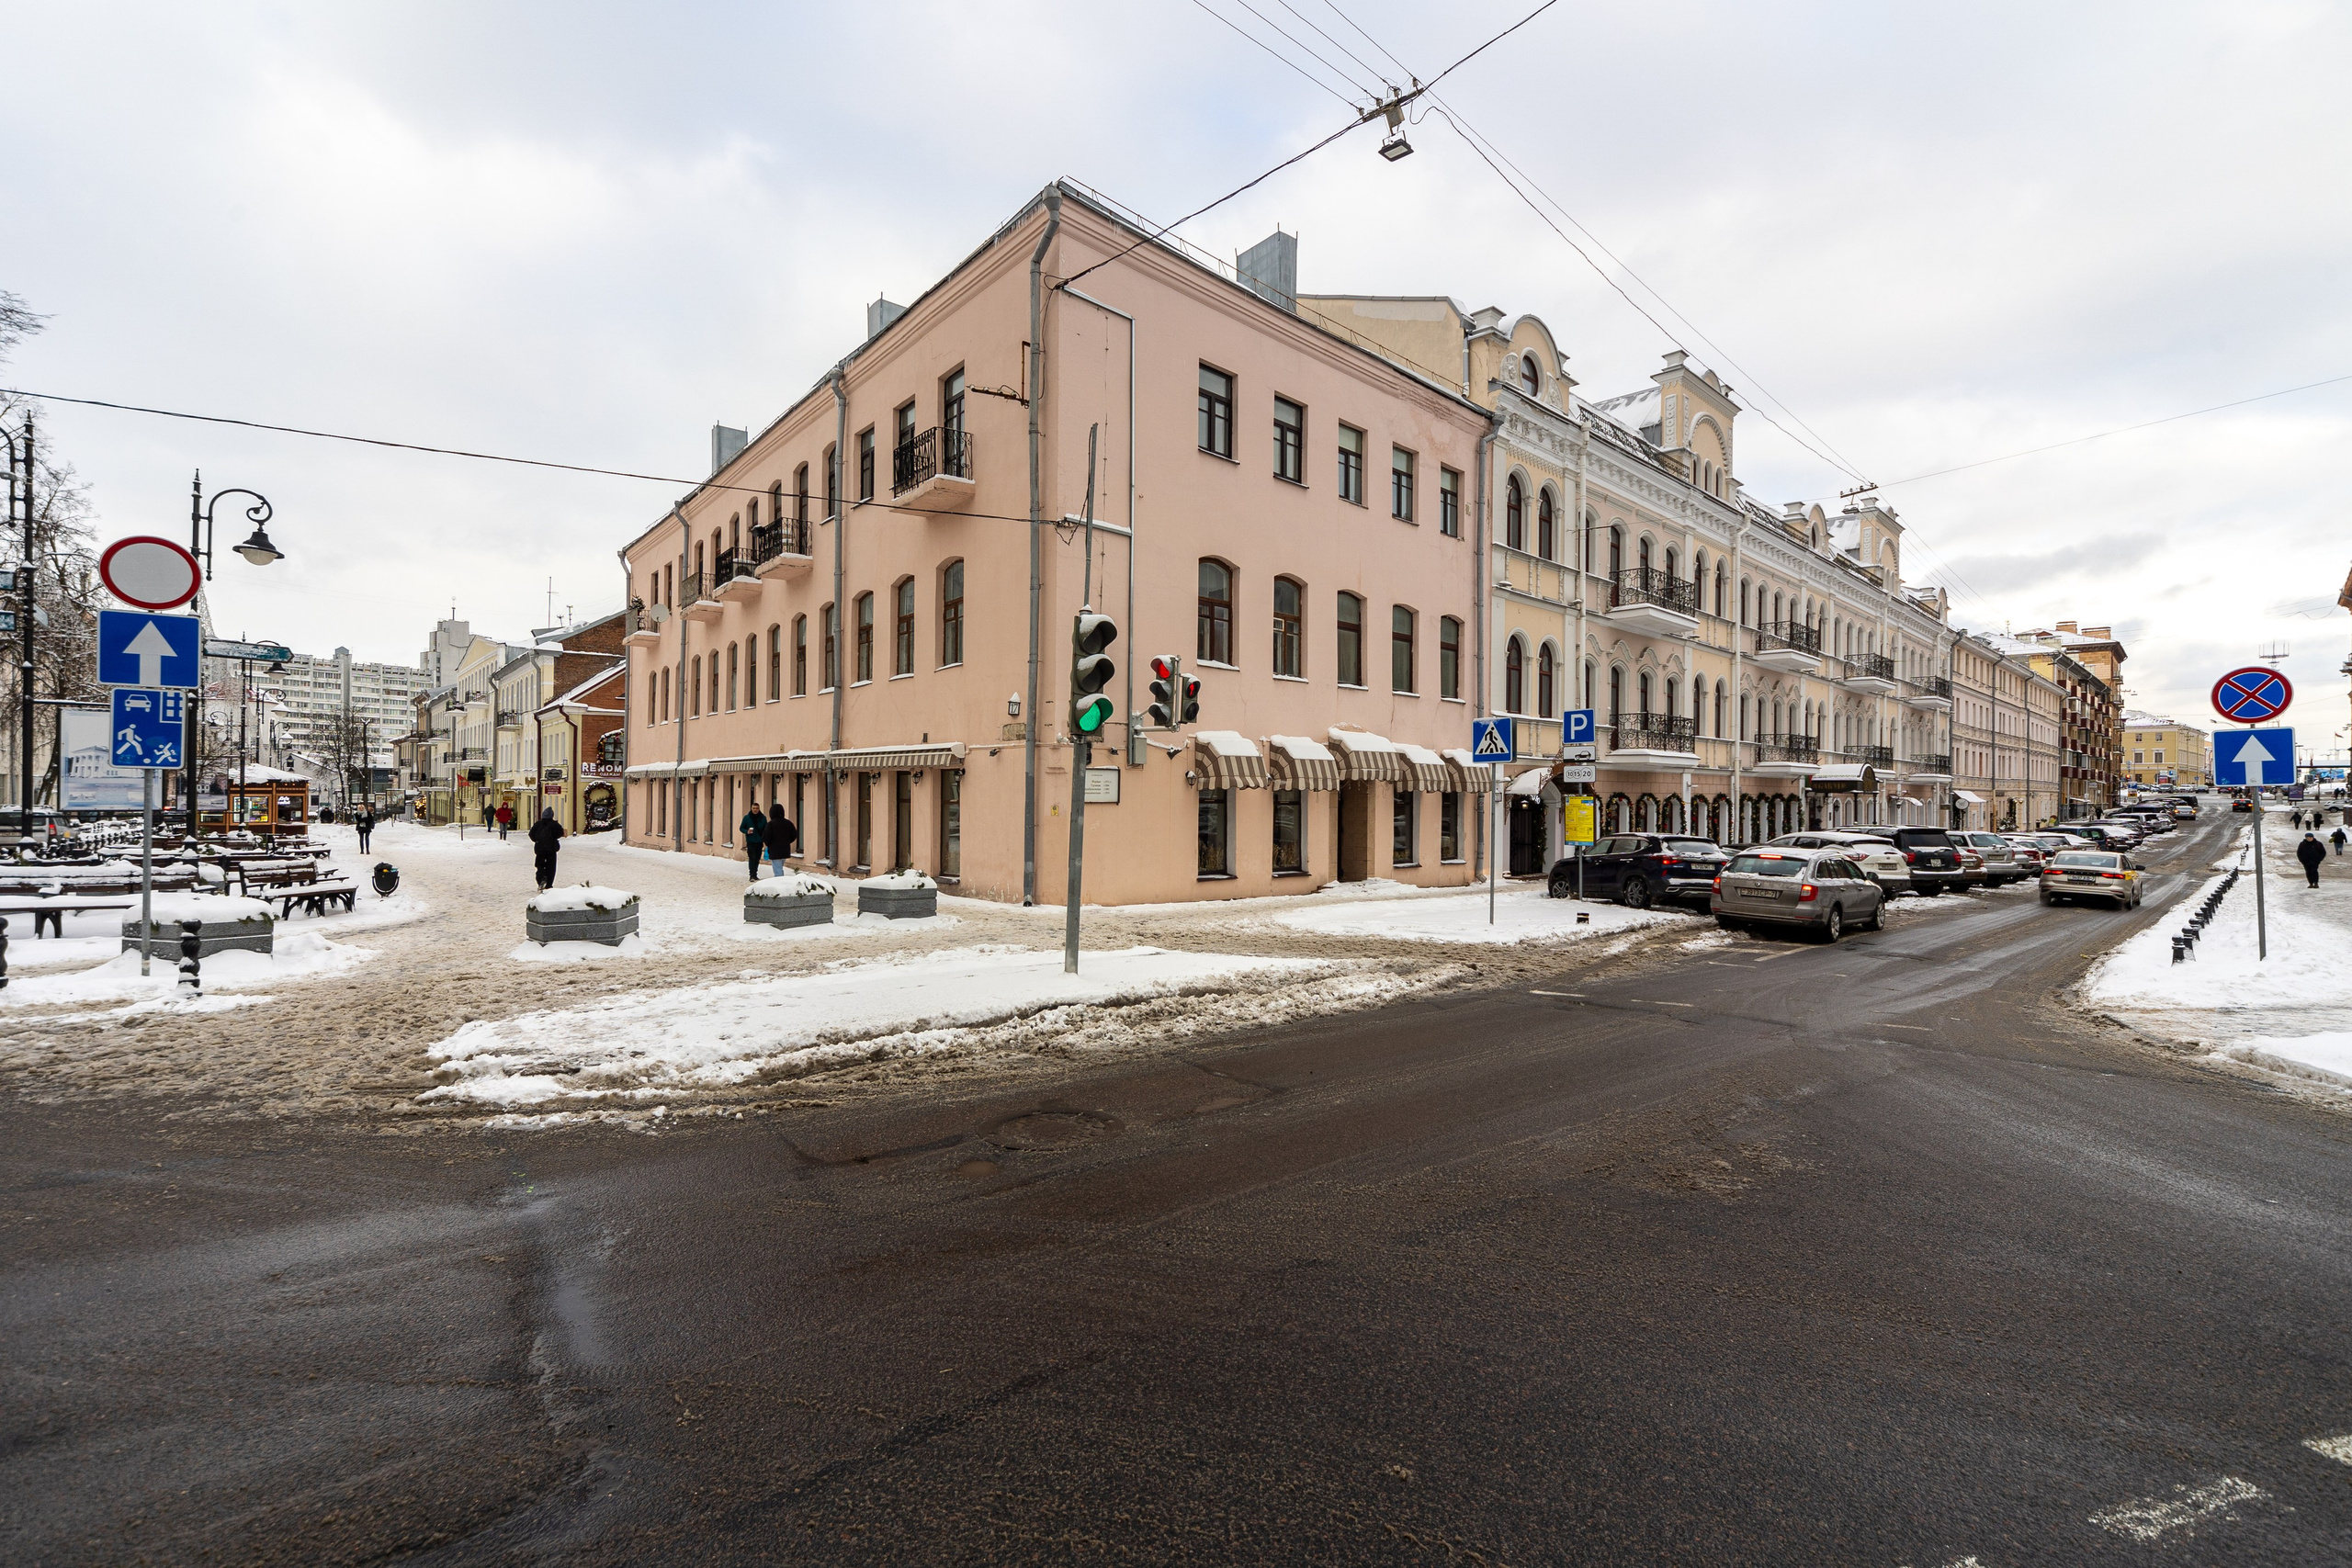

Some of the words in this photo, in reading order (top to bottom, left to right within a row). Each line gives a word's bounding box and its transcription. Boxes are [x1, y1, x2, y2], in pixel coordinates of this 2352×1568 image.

[1011, 704, 1019, 713] 17
[1571, 714, 1588, 740] P
[582, 761, 622, 772] RENOM
